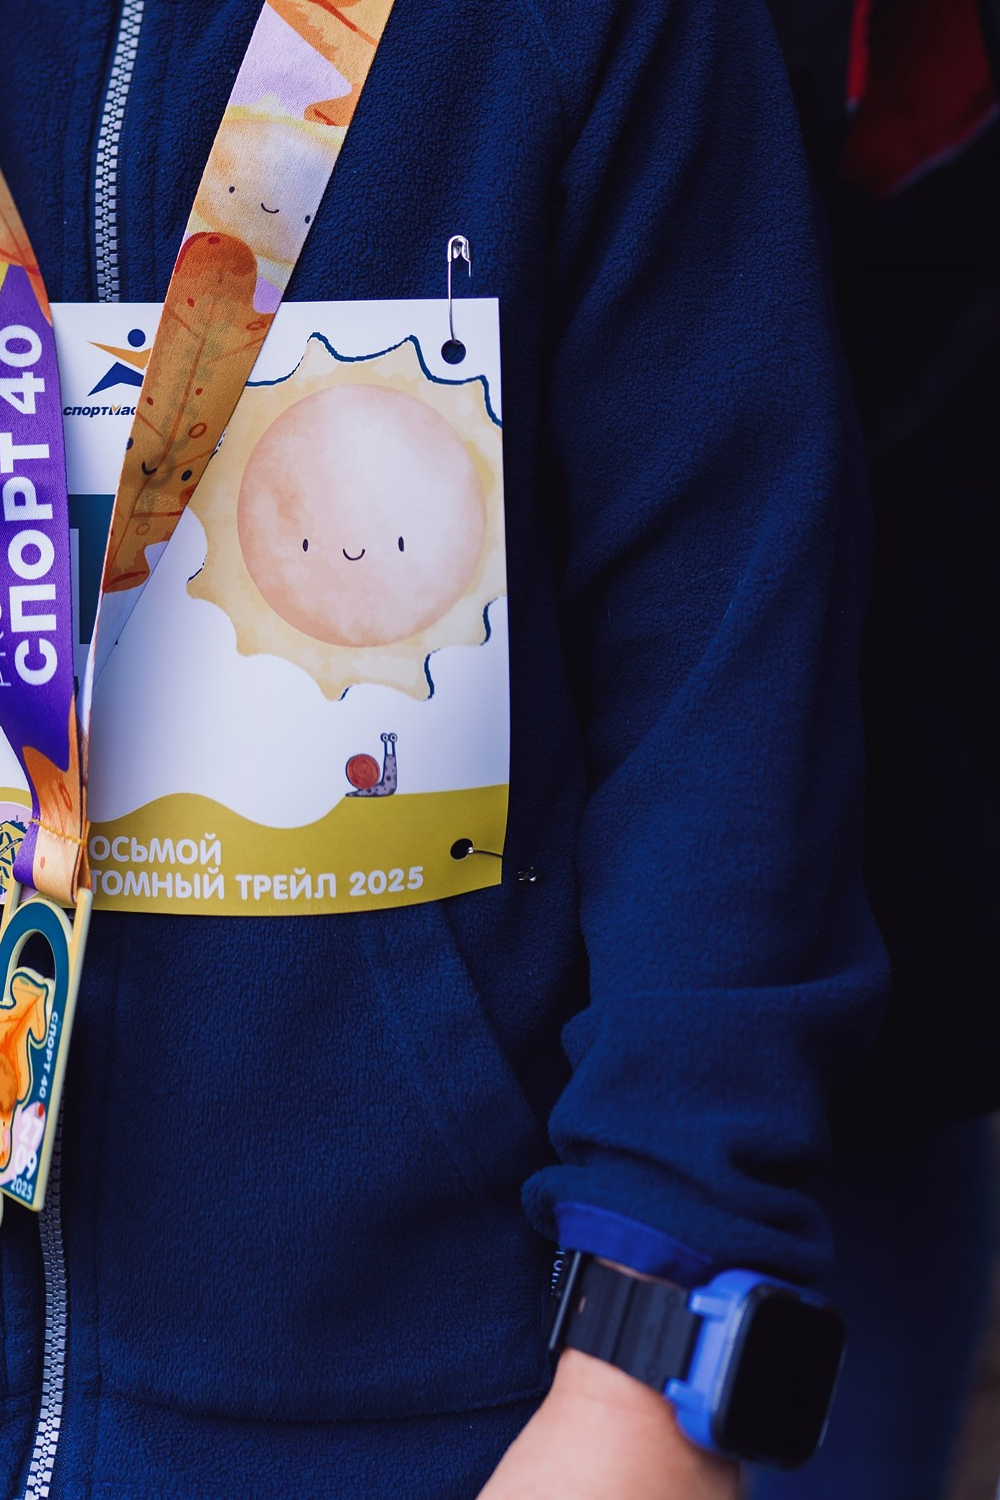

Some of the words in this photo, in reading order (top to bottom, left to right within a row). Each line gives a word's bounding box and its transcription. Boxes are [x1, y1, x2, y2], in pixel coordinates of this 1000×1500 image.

[235, 866, 337, 901] ТРЕЙЛ
[349, 867, 424, 897] 2025
[44, 1011, 59, 1074] СПОРТ
[39, 1074, 49, 1099] 40
[14, 1143, 38, 1181] 09
[10, 1177, 34, 1202] 2025
